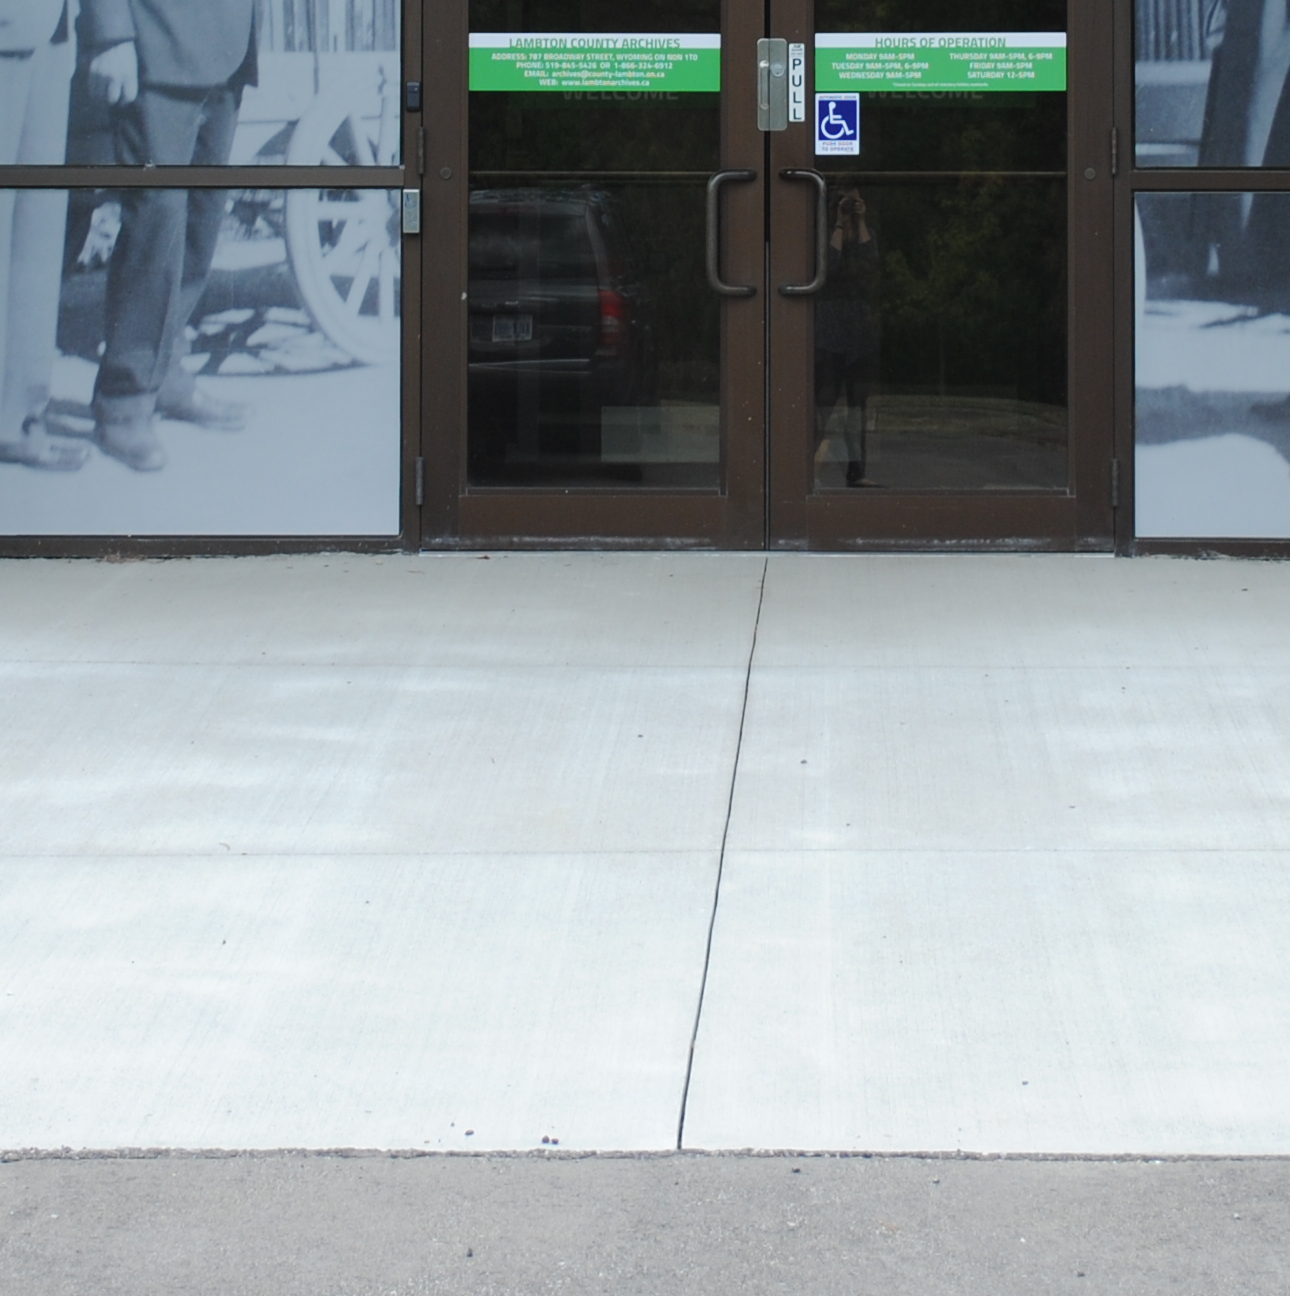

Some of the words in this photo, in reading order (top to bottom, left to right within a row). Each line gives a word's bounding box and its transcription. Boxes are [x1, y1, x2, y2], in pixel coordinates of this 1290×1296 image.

[509, 38, 567, 48] LAMBTON
[571, 38, 618, 48] COUNTY
[622, 38, 680, 48] ARCHIVES
[875, 37, 916, 48] HOURS
[919, 37, 935, 48] OF
[938, 37, 1006, 48] OPERATION
[586, 53, 615, 61] STREET,
[832, 62, 863, 70] TUESDAY
[839, 71, 884, 79] WEDNESDAY
[886, 71, 922, 79] 9AM-5PM
[792, 58, 803, 120] PULL
